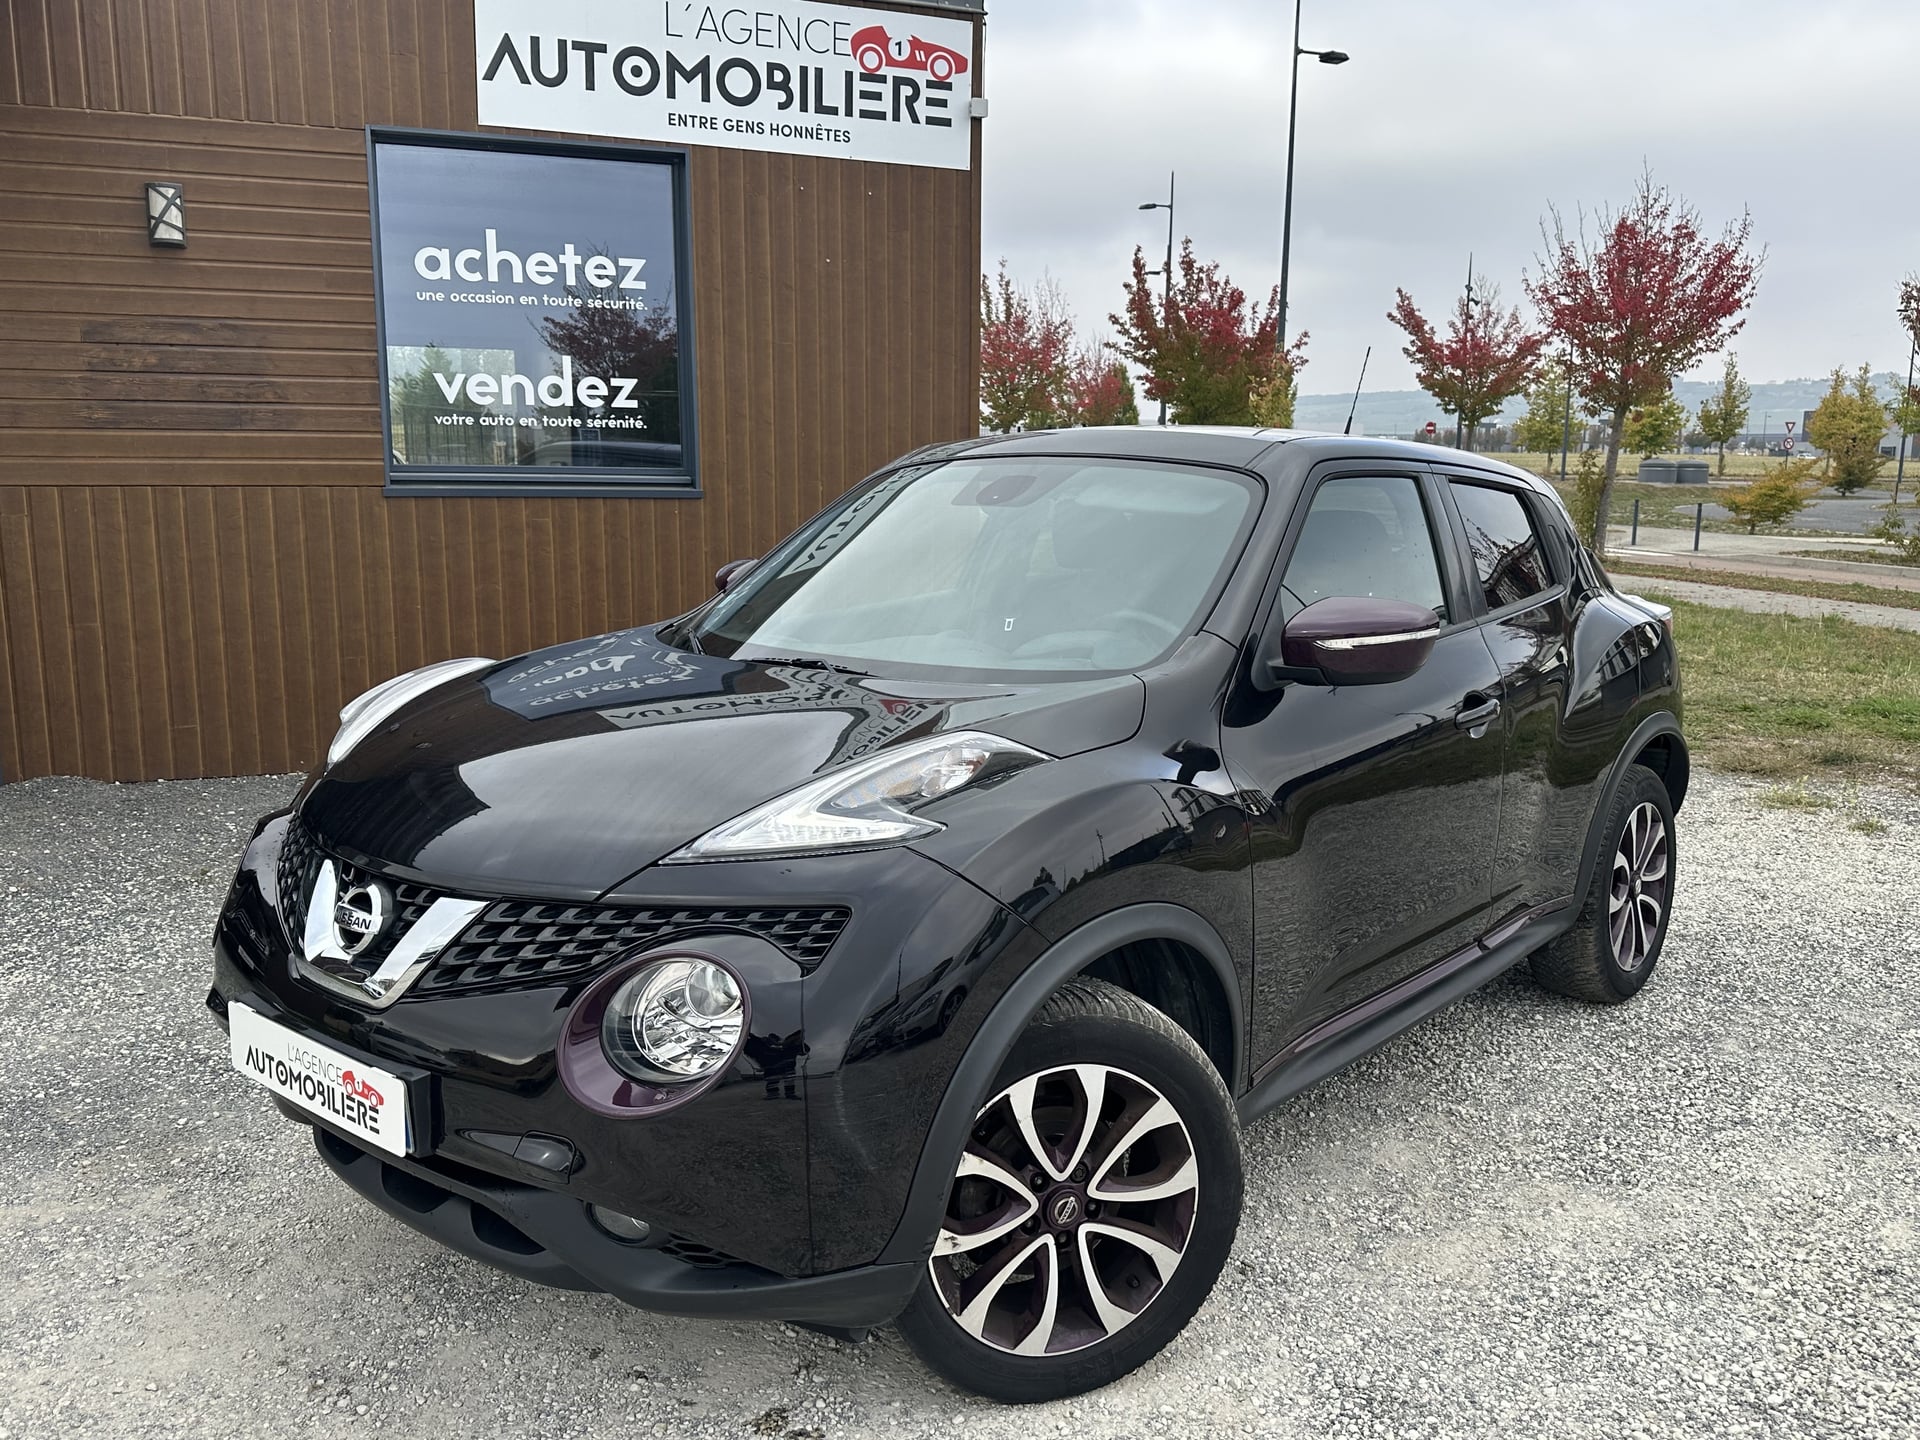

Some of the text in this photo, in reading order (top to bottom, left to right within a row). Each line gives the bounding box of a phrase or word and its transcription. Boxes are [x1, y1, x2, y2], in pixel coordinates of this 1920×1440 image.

[668, 112, 851, 144] ENTRE GENS HONNÊTES
[414, 228, 647, 290] achetez
[416, 291, 649, 311] une occasion en toute sécurité.
[432, 355, 638, 409] vendez
[434, 413, 648, 430] votre auto en toute sérénité.
